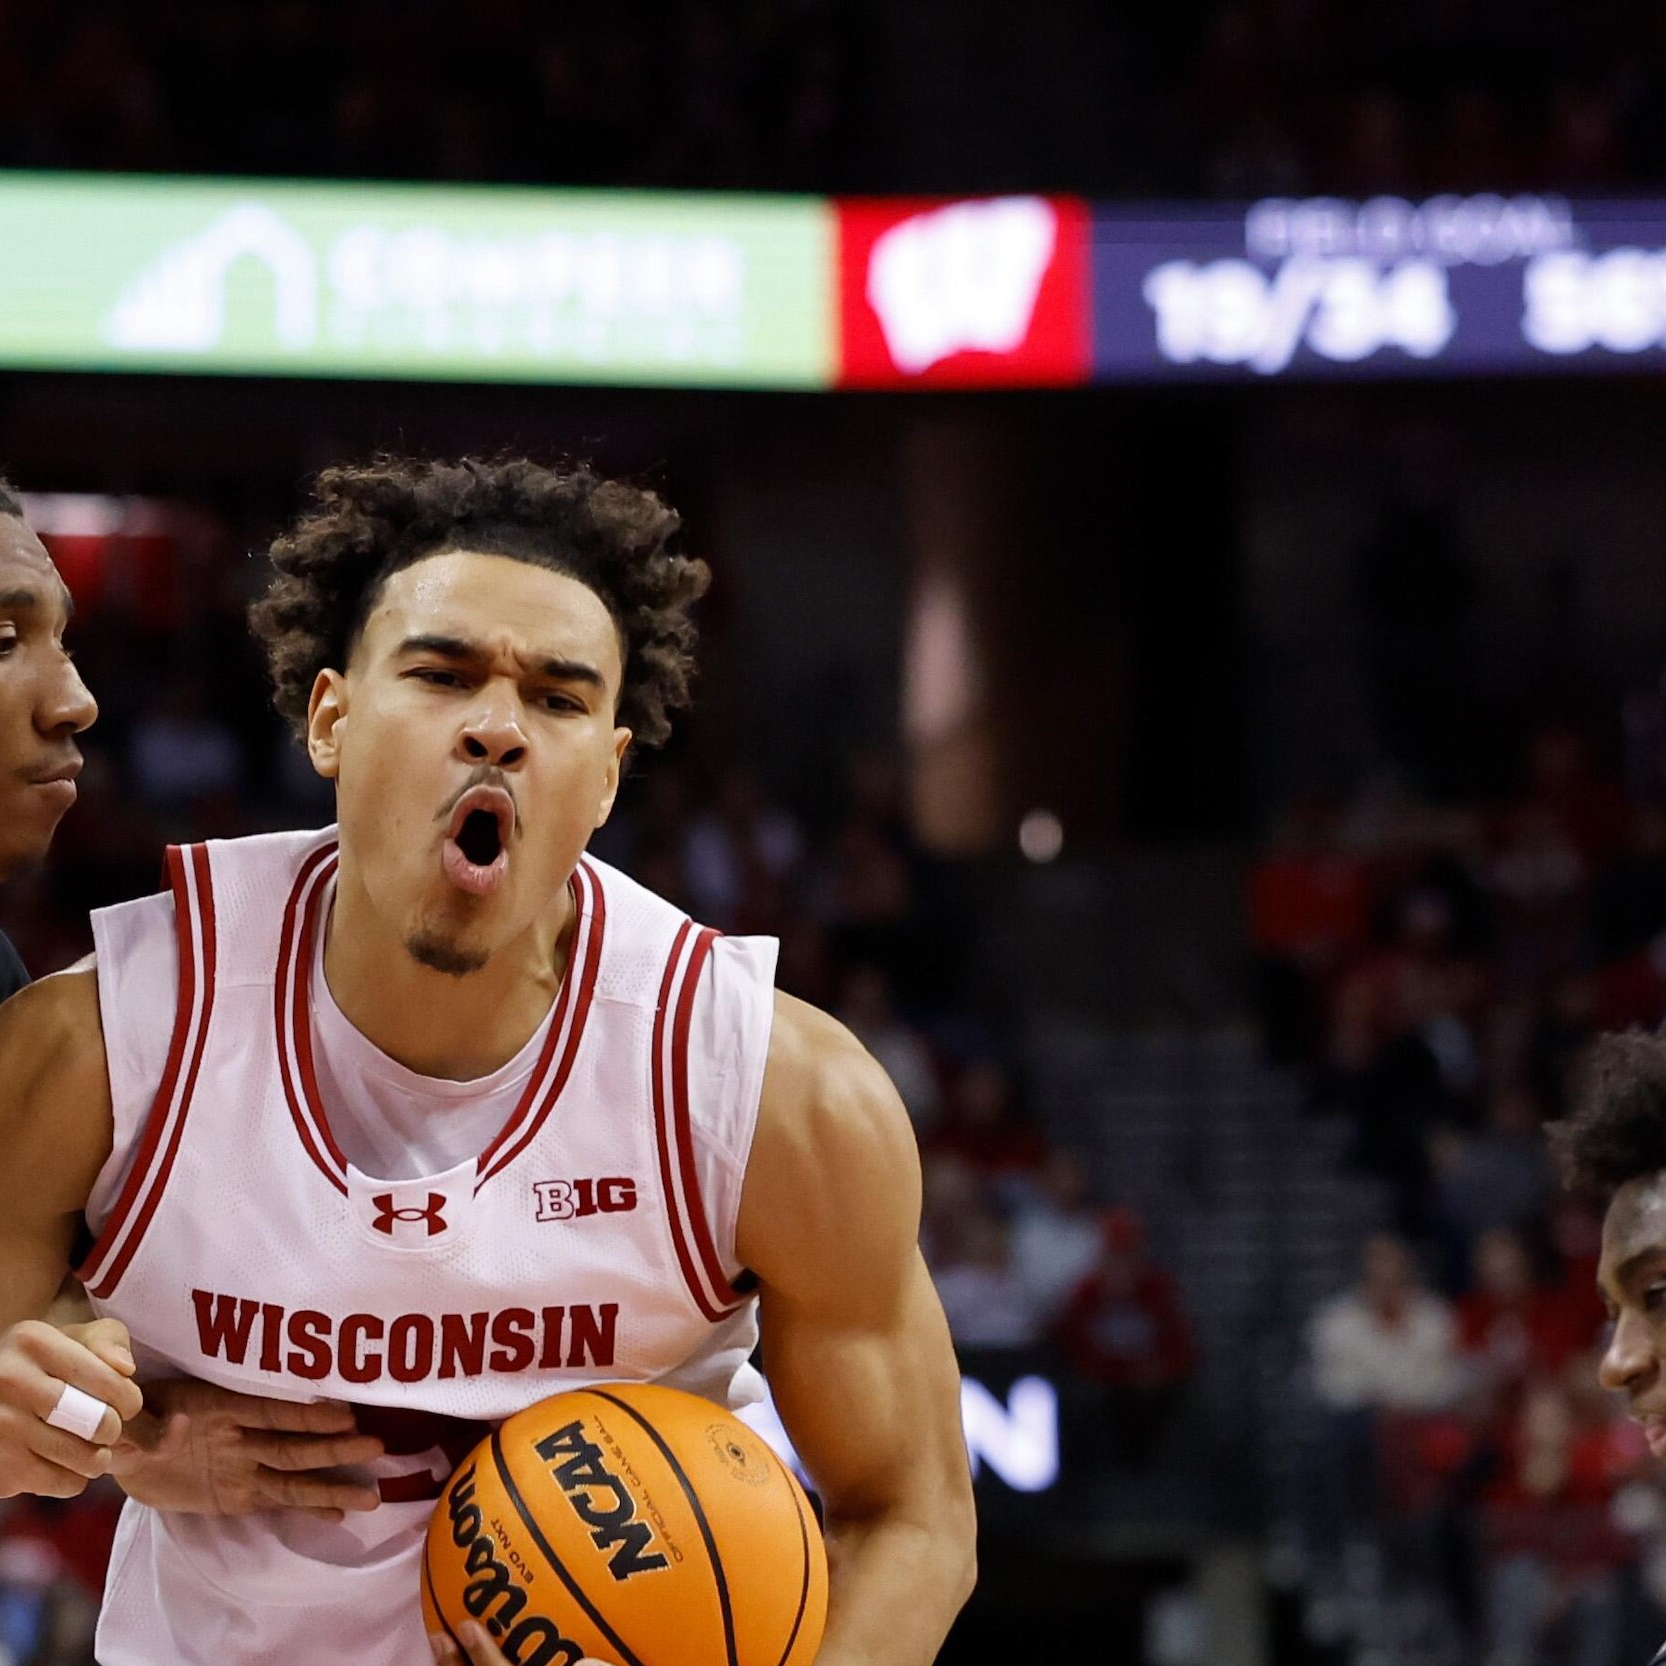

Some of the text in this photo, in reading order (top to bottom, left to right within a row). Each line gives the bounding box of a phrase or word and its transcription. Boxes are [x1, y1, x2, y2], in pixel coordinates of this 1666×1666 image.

[191, 1288, 619, 1384] WISCONSIN
[533, 1418, 673, 1582] NCAA
[490, 1517, 534, 1586] EVO NXT
